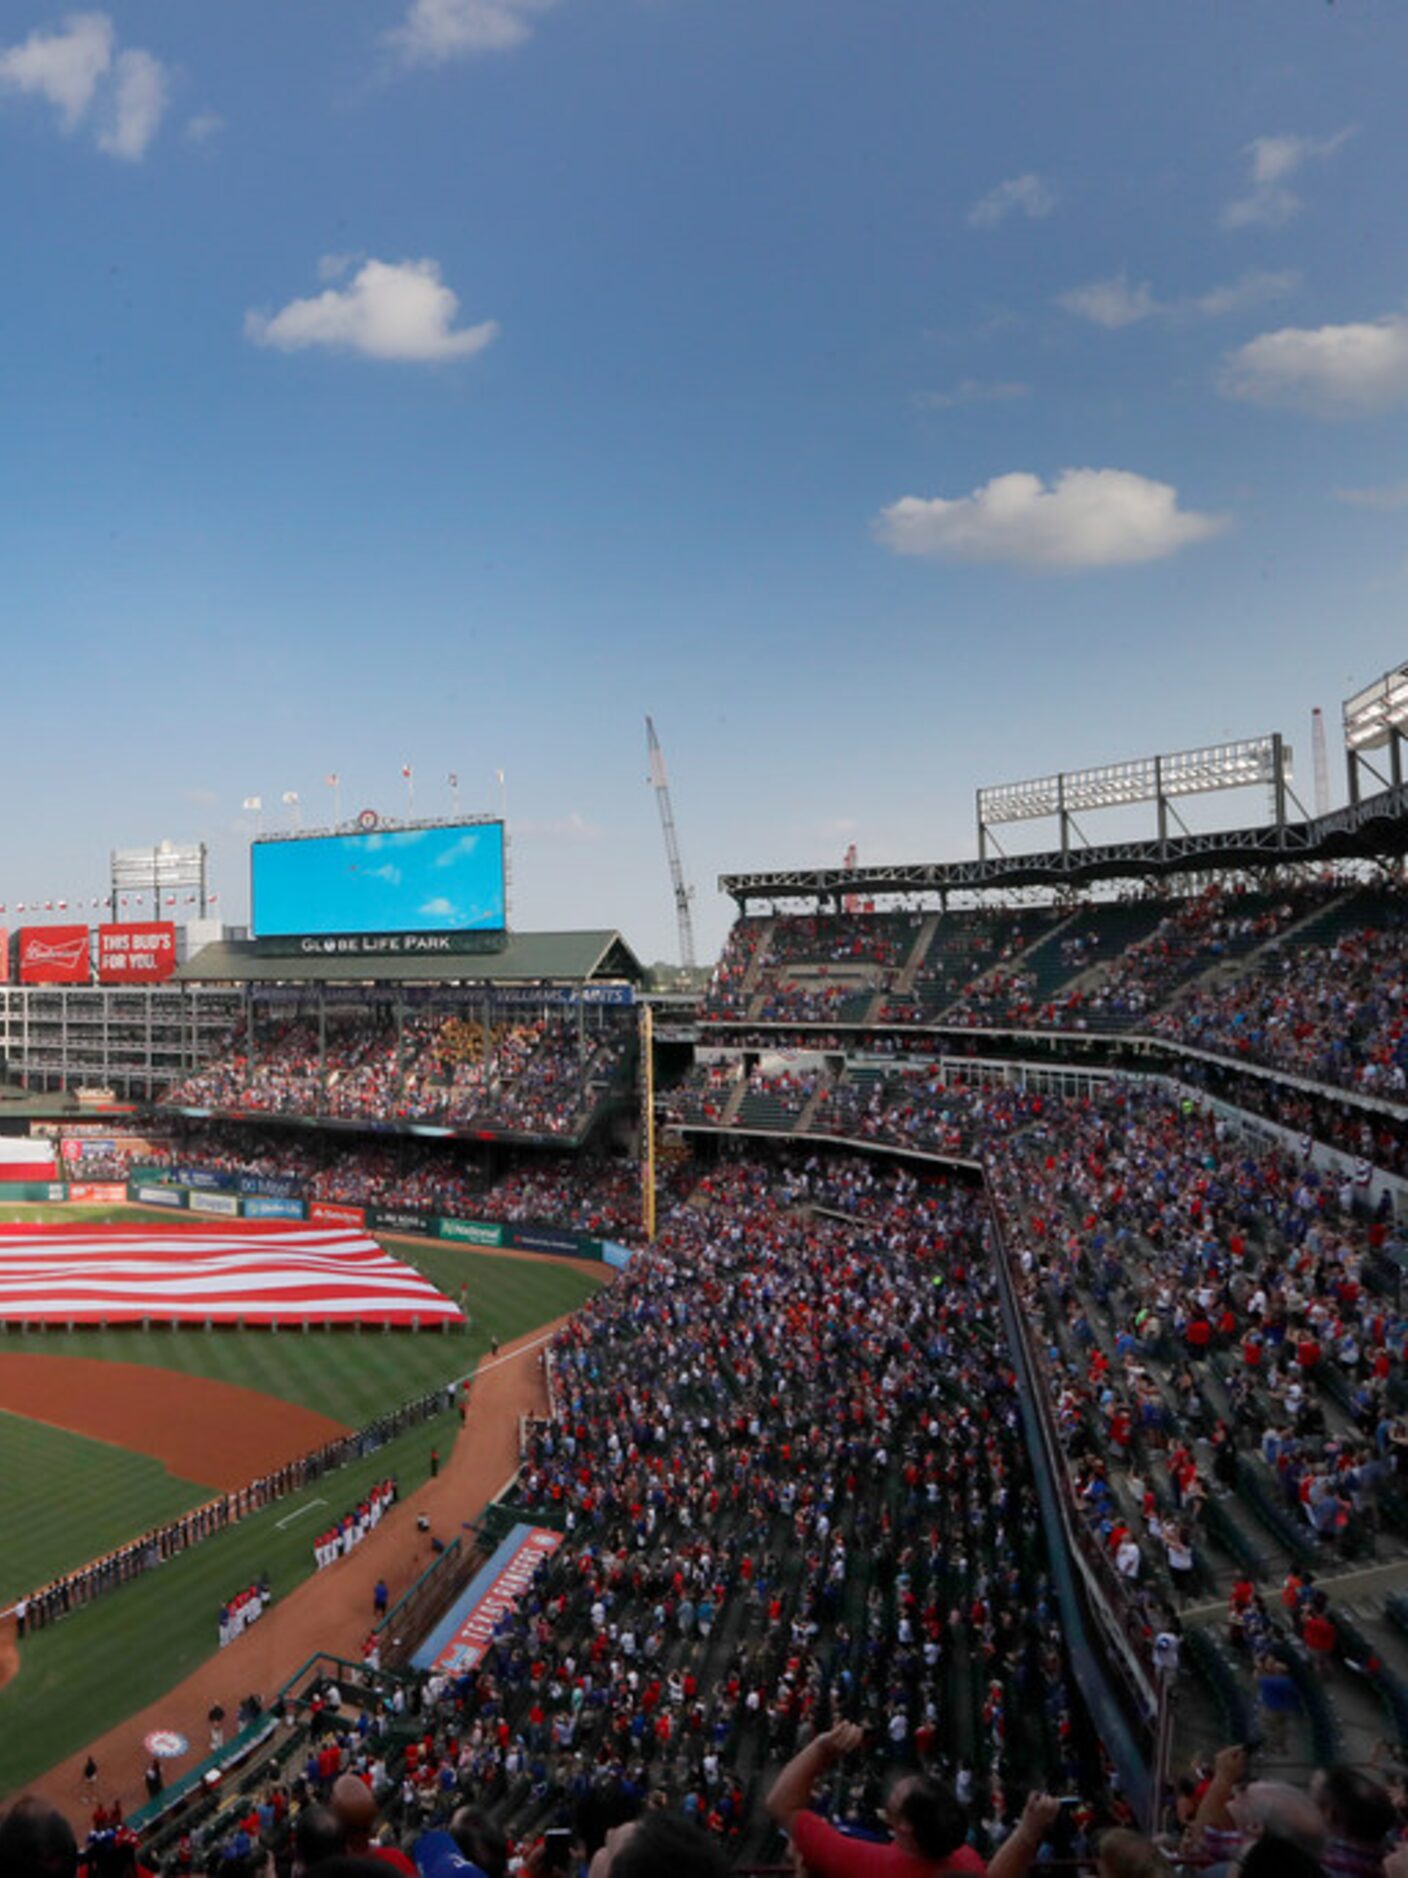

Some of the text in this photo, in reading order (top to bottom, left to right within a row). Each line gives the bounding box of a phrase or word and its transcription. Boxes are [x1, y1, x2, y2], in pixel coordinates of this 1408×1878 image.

[102, 933, 172, 950] THIS BUD'S
[301, 935, 451, 952] GLOBE LIFE PARK
[102, 954, 127, 969] FOR
